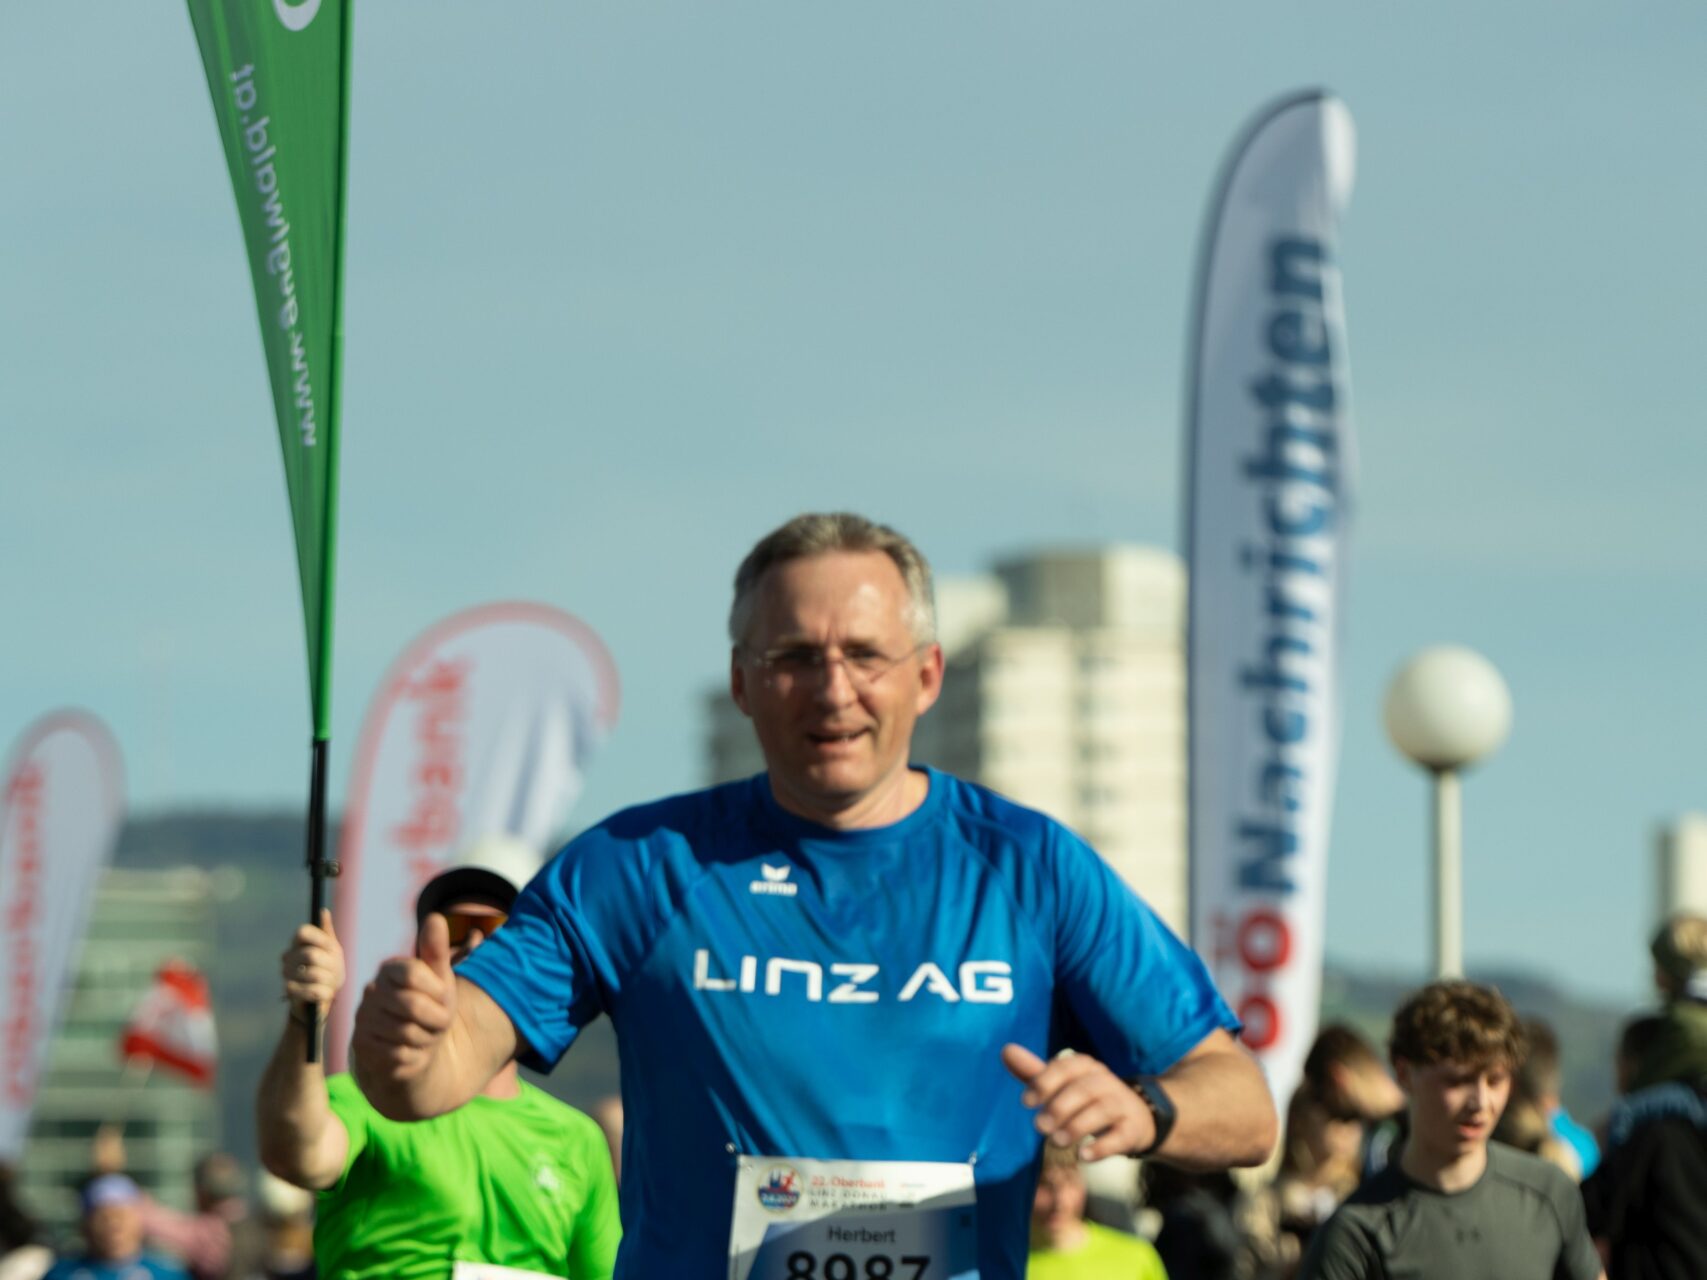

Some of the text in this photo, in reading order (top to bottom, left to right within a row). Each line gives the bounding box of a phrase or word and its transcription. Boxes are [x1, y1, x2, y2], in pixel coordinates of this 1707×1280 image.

[694, 949, 1013, 1004] LINZ AG
[828, 1227, 897, 1243] Herbert
